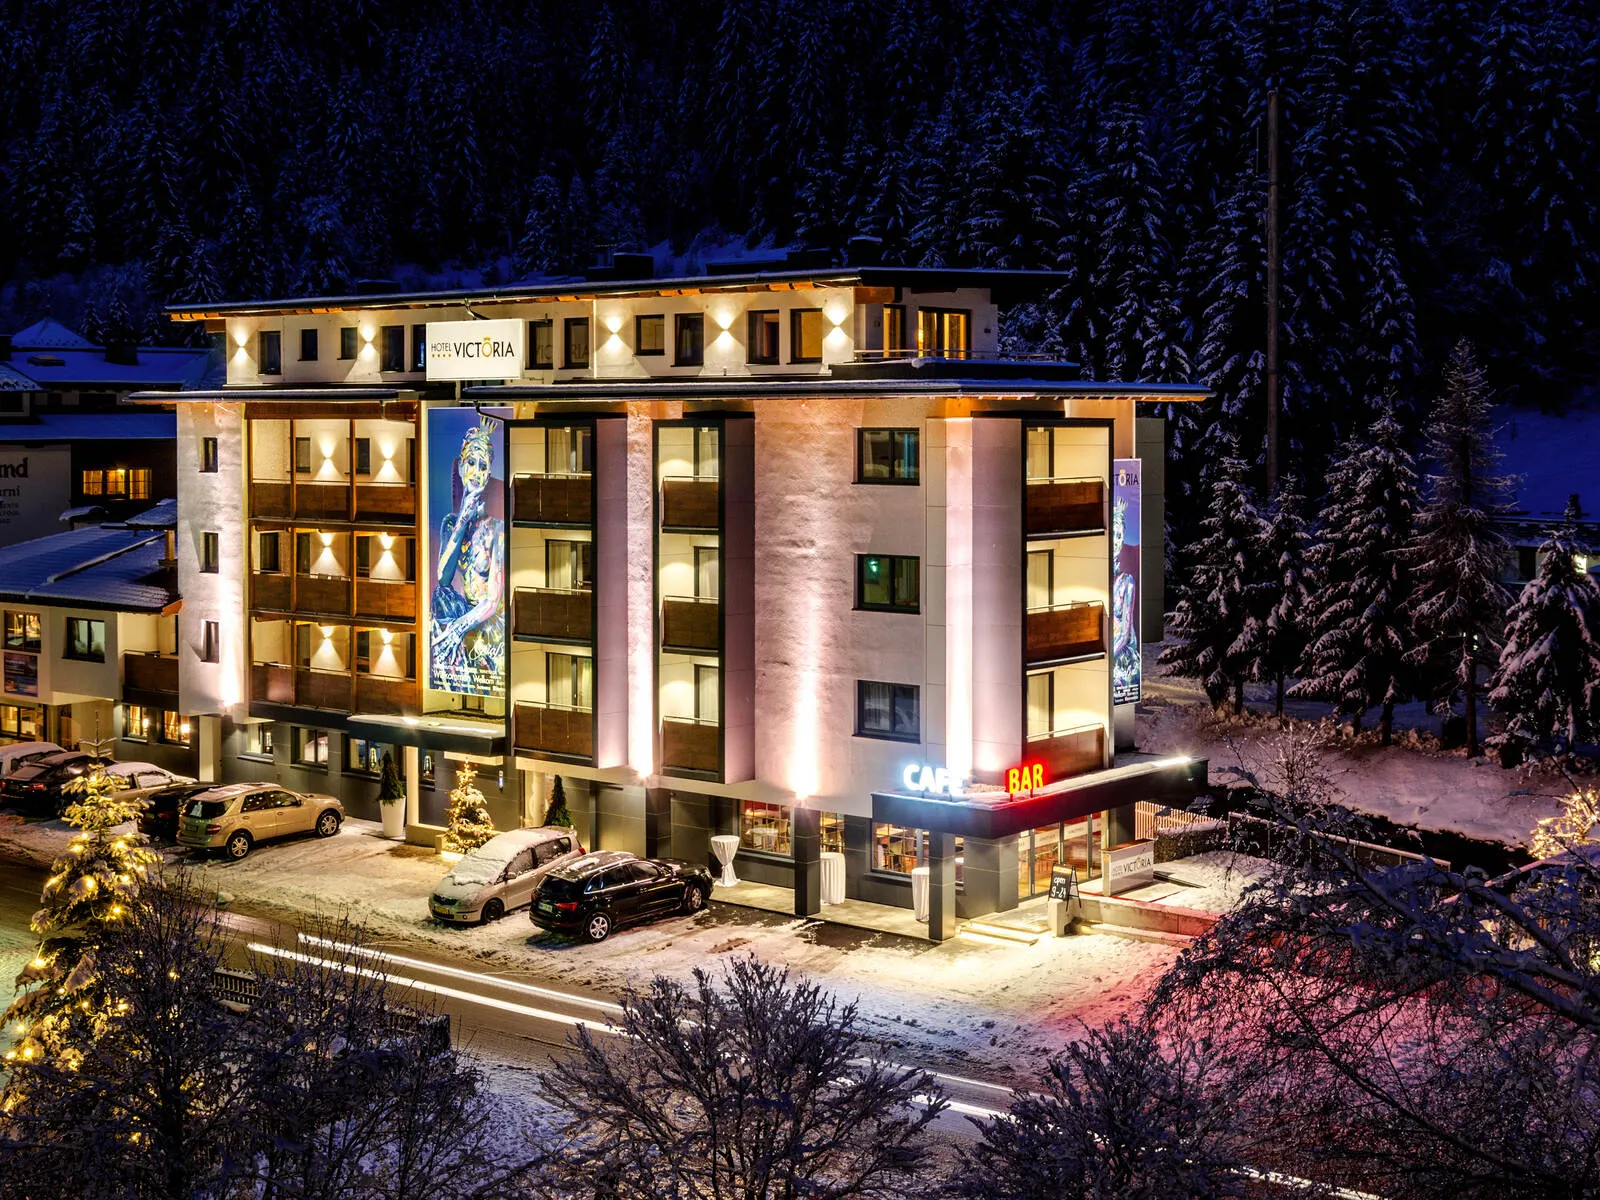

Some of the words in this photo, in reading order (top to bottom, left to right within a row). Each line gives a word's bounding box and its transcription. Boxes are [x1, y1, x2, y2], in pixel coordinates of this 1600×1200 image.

[431, 343, 452, 352] HOTEL
[454, 339, 514, 358] VICTORIA
[0, 457, 28, 478] nd
[1113, 469, 1139, 486] TORIA
[1009, 764, 1043, 794] BAR
[1123, 857, 1151, 873] VICTORIA
